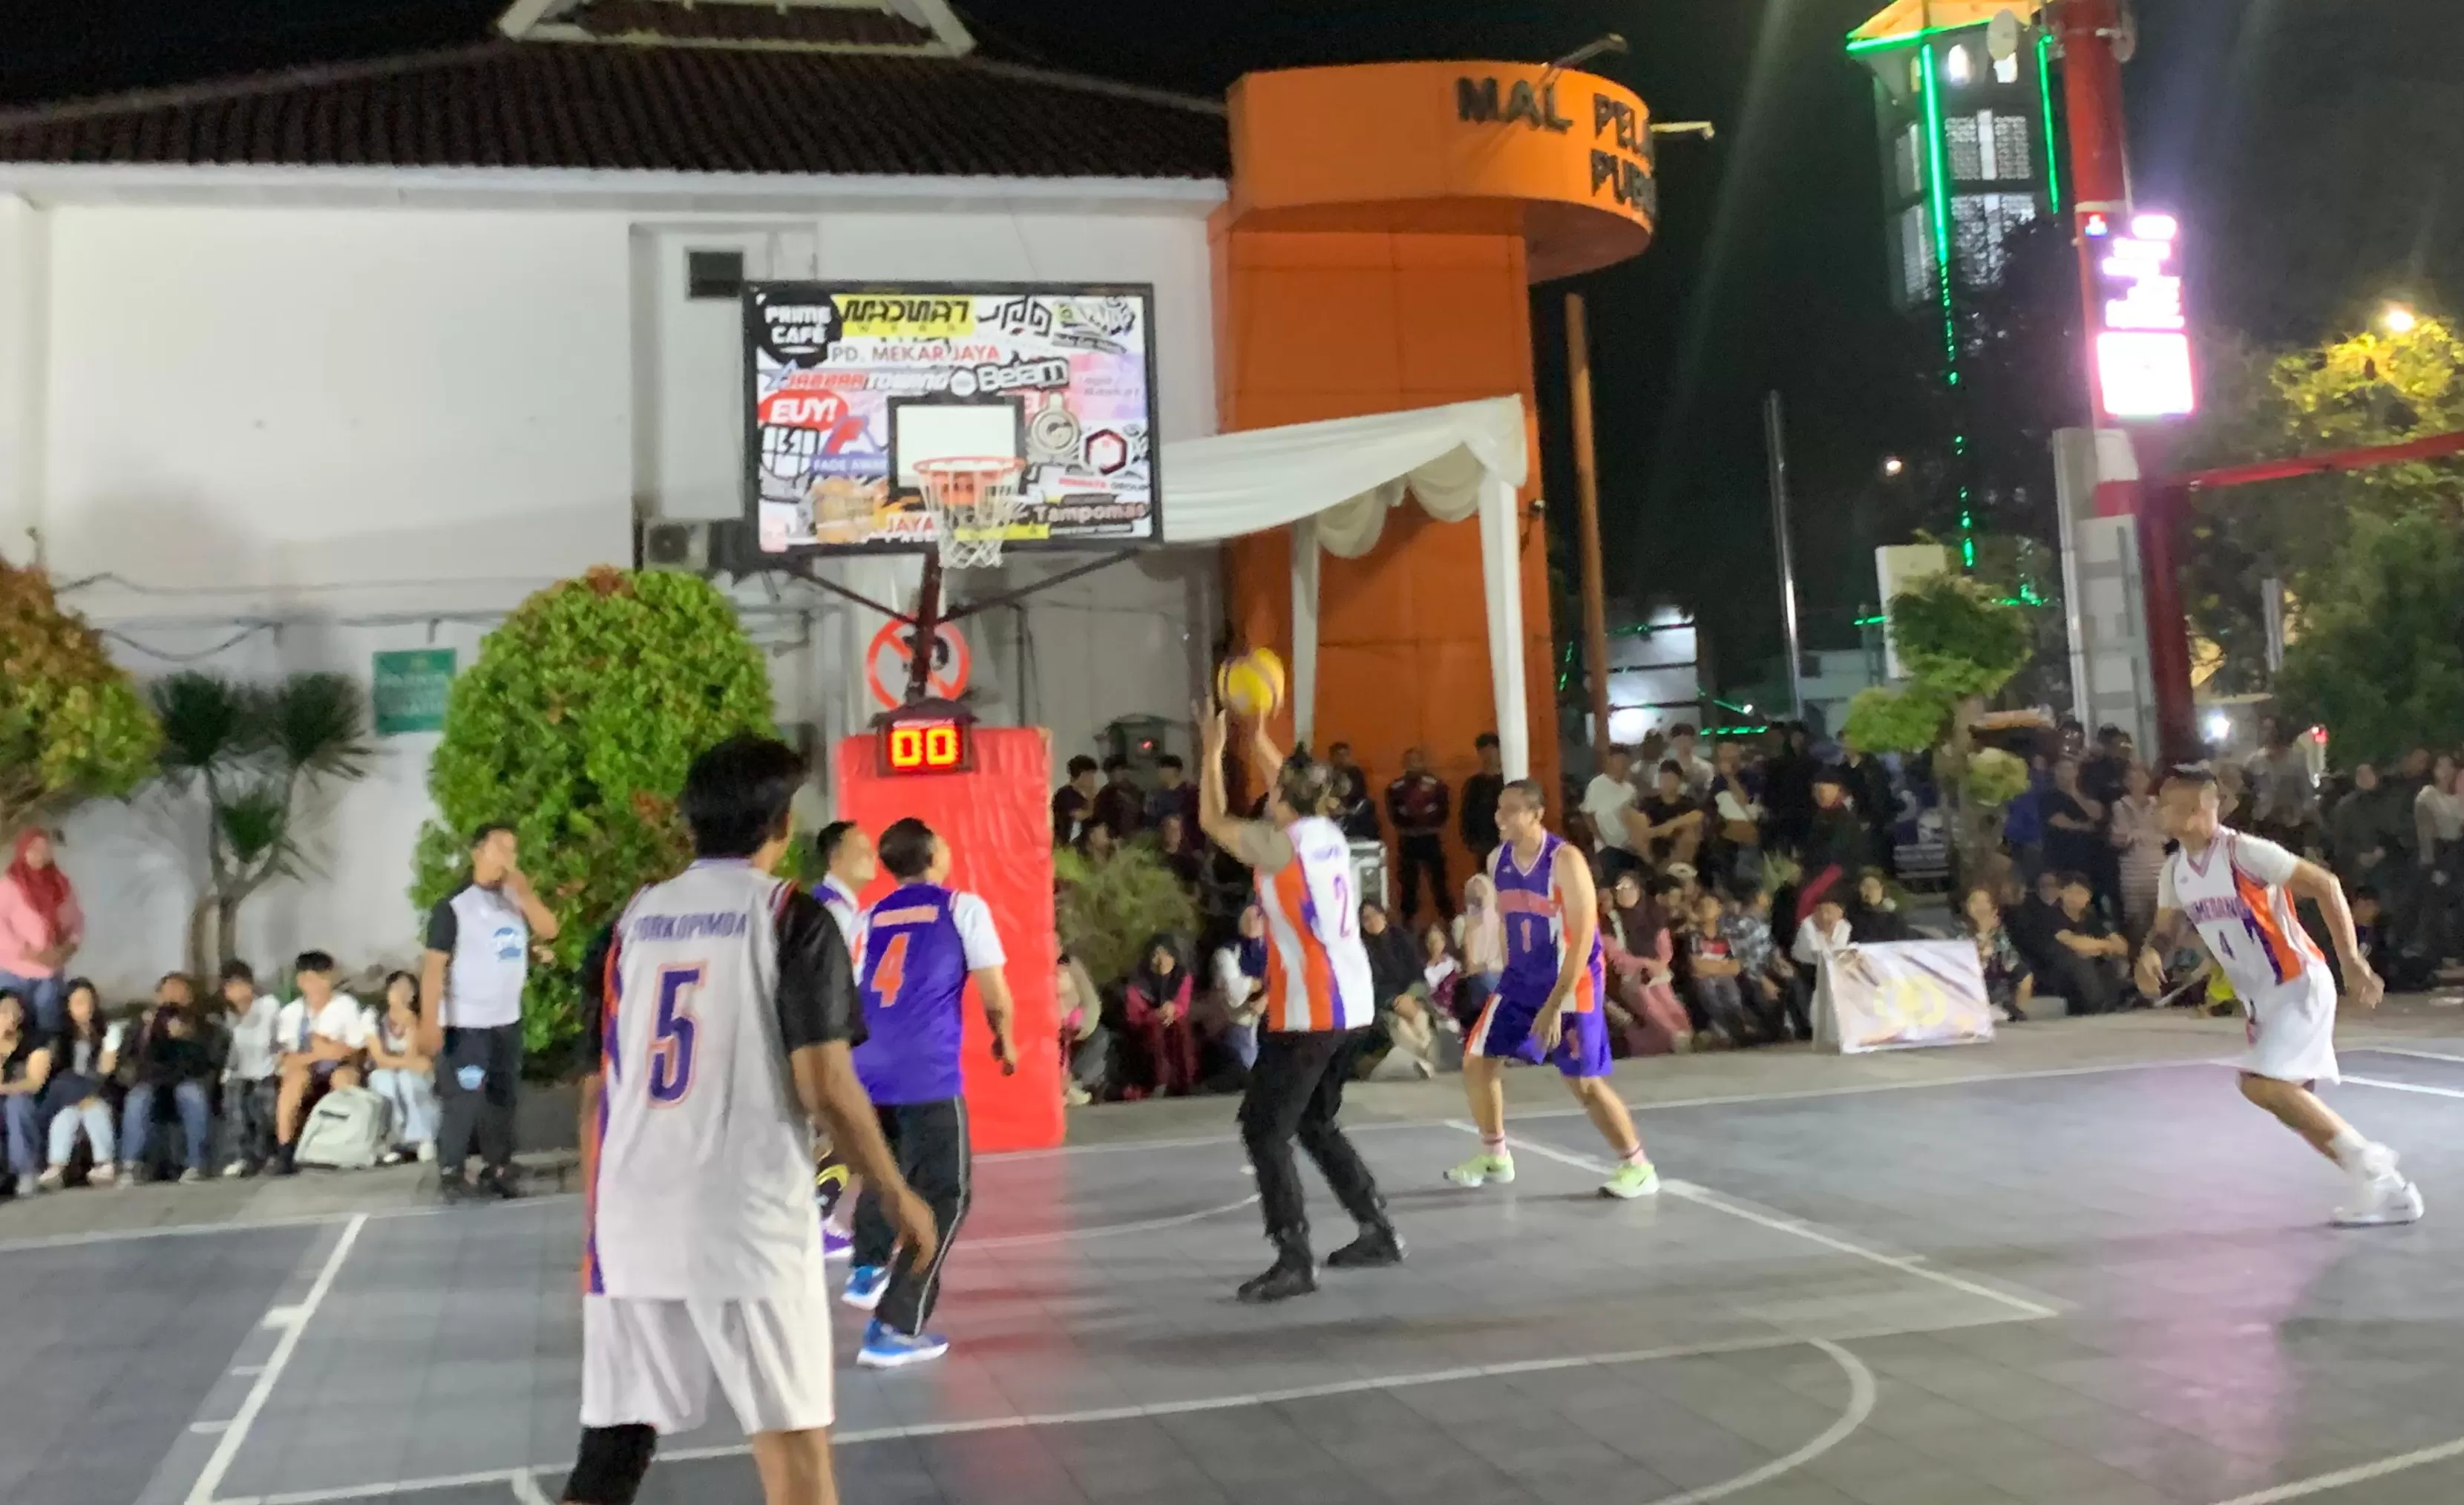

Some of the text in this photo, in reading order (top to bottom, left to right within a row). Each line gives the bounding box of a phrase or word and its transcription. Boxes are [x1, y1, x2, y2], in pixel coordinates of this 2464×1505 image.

[1456, 76, 1573, 134] MAL
[832, 344, 1000, 363] PD. MEKAR JAYA
[770, 398, 838, 424] EUY!
[891, 728, 959, 767] 00
[1521, 917, 1532, 953] 1
[870, 932, 911, 1008] 4
[647, 962, 707, 1109] 5
